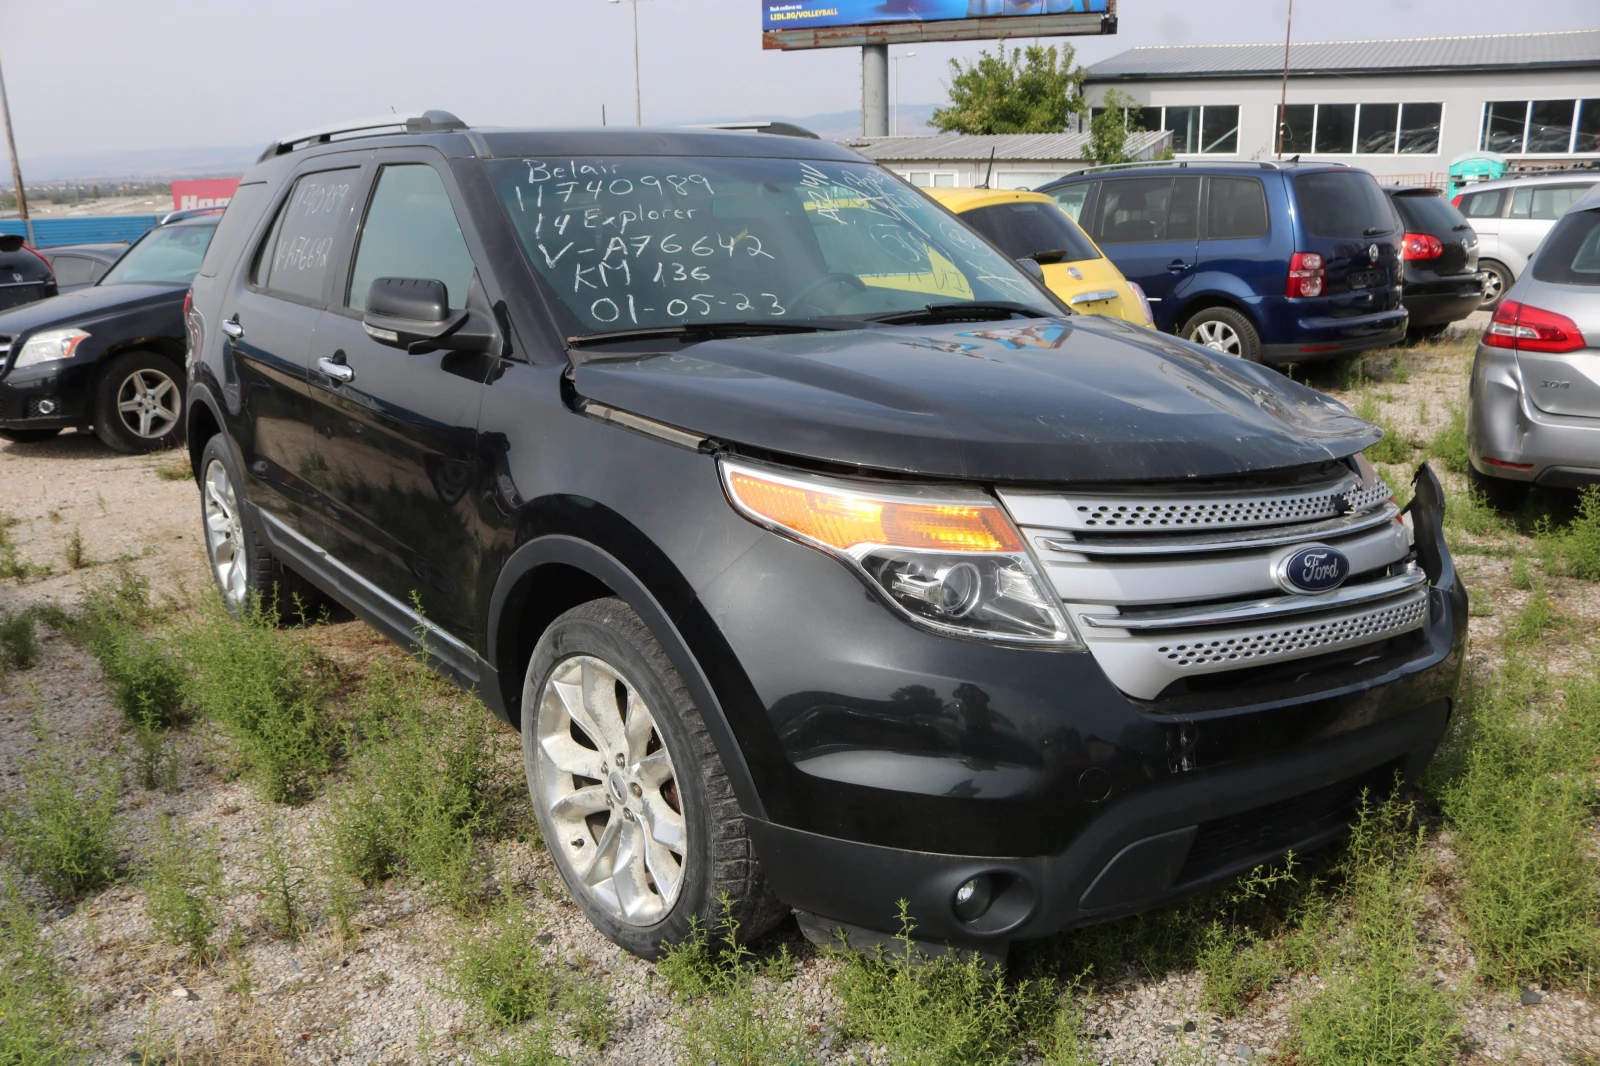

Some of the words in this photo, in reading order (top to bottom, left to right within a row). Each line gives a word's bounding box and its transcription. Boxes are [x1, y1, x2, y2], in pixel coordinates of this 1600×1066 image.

[770, 8, 838, 20] LIDL.BG/VOLLEYBALL
[523, 159, 619, 183] Belair
[515, 174, 715, 212] 11740989
[535, 213, 571, 239] 14
[584, 204, 698, 235] Explorer
[575, 259, 632, 293] KM
[653, 262, 711, 287] 136
[591, 293, 786, 325] 01-05-23
[1540, 380, 1570, 389] 308
[1303, 553, 1338, 582] Ford
